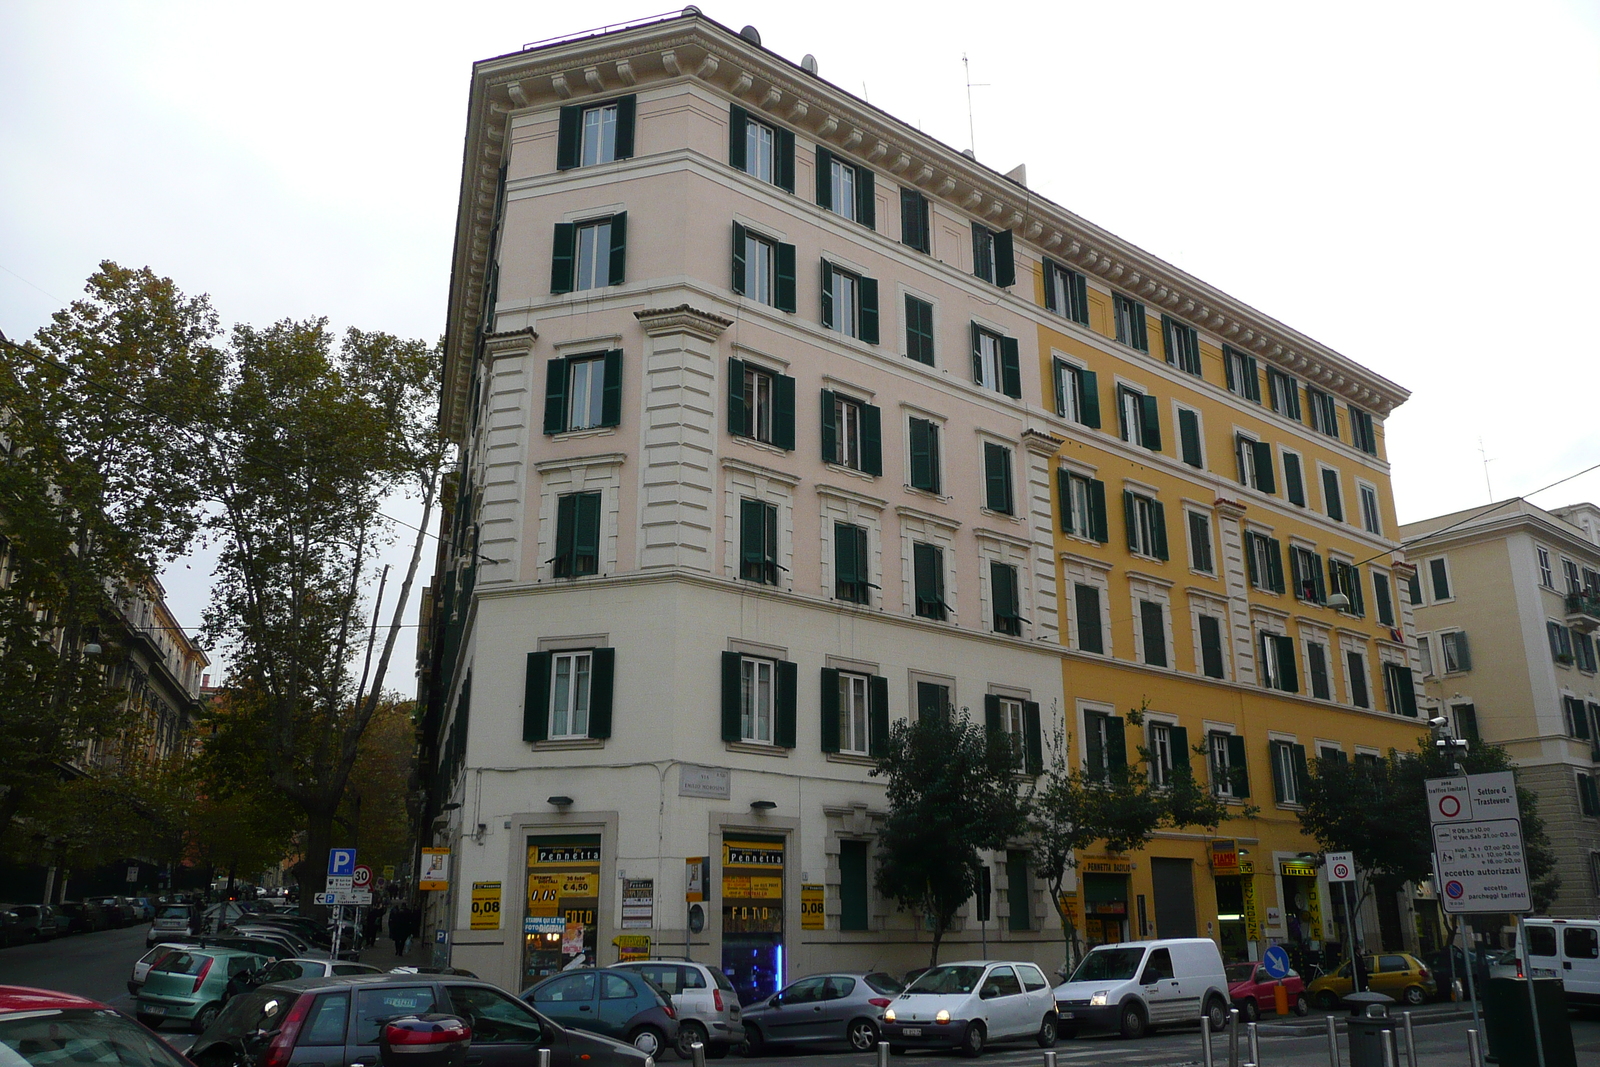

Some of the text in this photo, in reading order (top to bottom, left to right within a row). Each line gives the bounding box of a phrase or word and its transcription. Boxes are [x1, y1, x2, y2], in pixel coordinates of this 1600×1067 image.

[540, 852, 598, 860] Pennetta
[731, 853, 781, 863] Pennetta
[1213, 853, 1236, 863] FIAMM
[333, 851, 350, 872] P
[1088, 863, 1111, 871] PENNETTA
[1282, 864, 1316, 875] PIRELLI
[1477, 867, 1521, 875] autorizzati
[355, 871, 367, 881] 30
[472, 902, 500, 915] 0,08
[732, 907, 768, 920] FOTO
[801, 903, 824, 916] 0,08
[1308, 881, 1320, 938] GOMME
[565, 910, 592, 924] FOTO
[539, 924, 565, 933] DIGITALI
[437, 932, 444, 940] P
